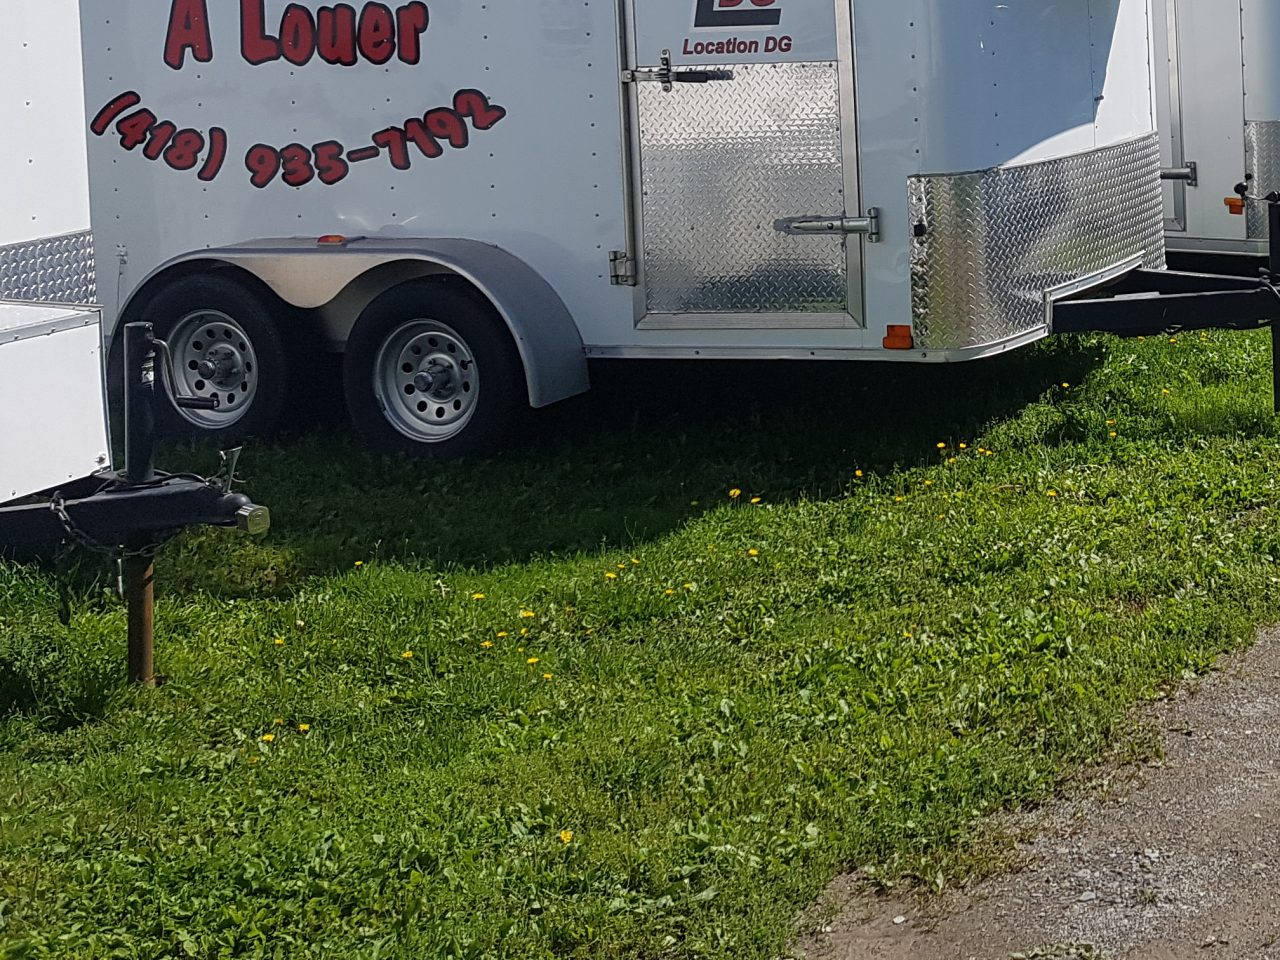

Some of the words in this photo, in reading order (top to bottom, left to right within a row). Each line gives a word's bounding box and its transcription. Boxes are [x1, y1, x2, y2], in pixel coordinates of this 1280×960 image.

[682, 38, 759, 55] Location
[764, 35, 792, 53] DG
[90, 91, 227, 181] (418)
[245, 89, 506, 188] 935-7192
